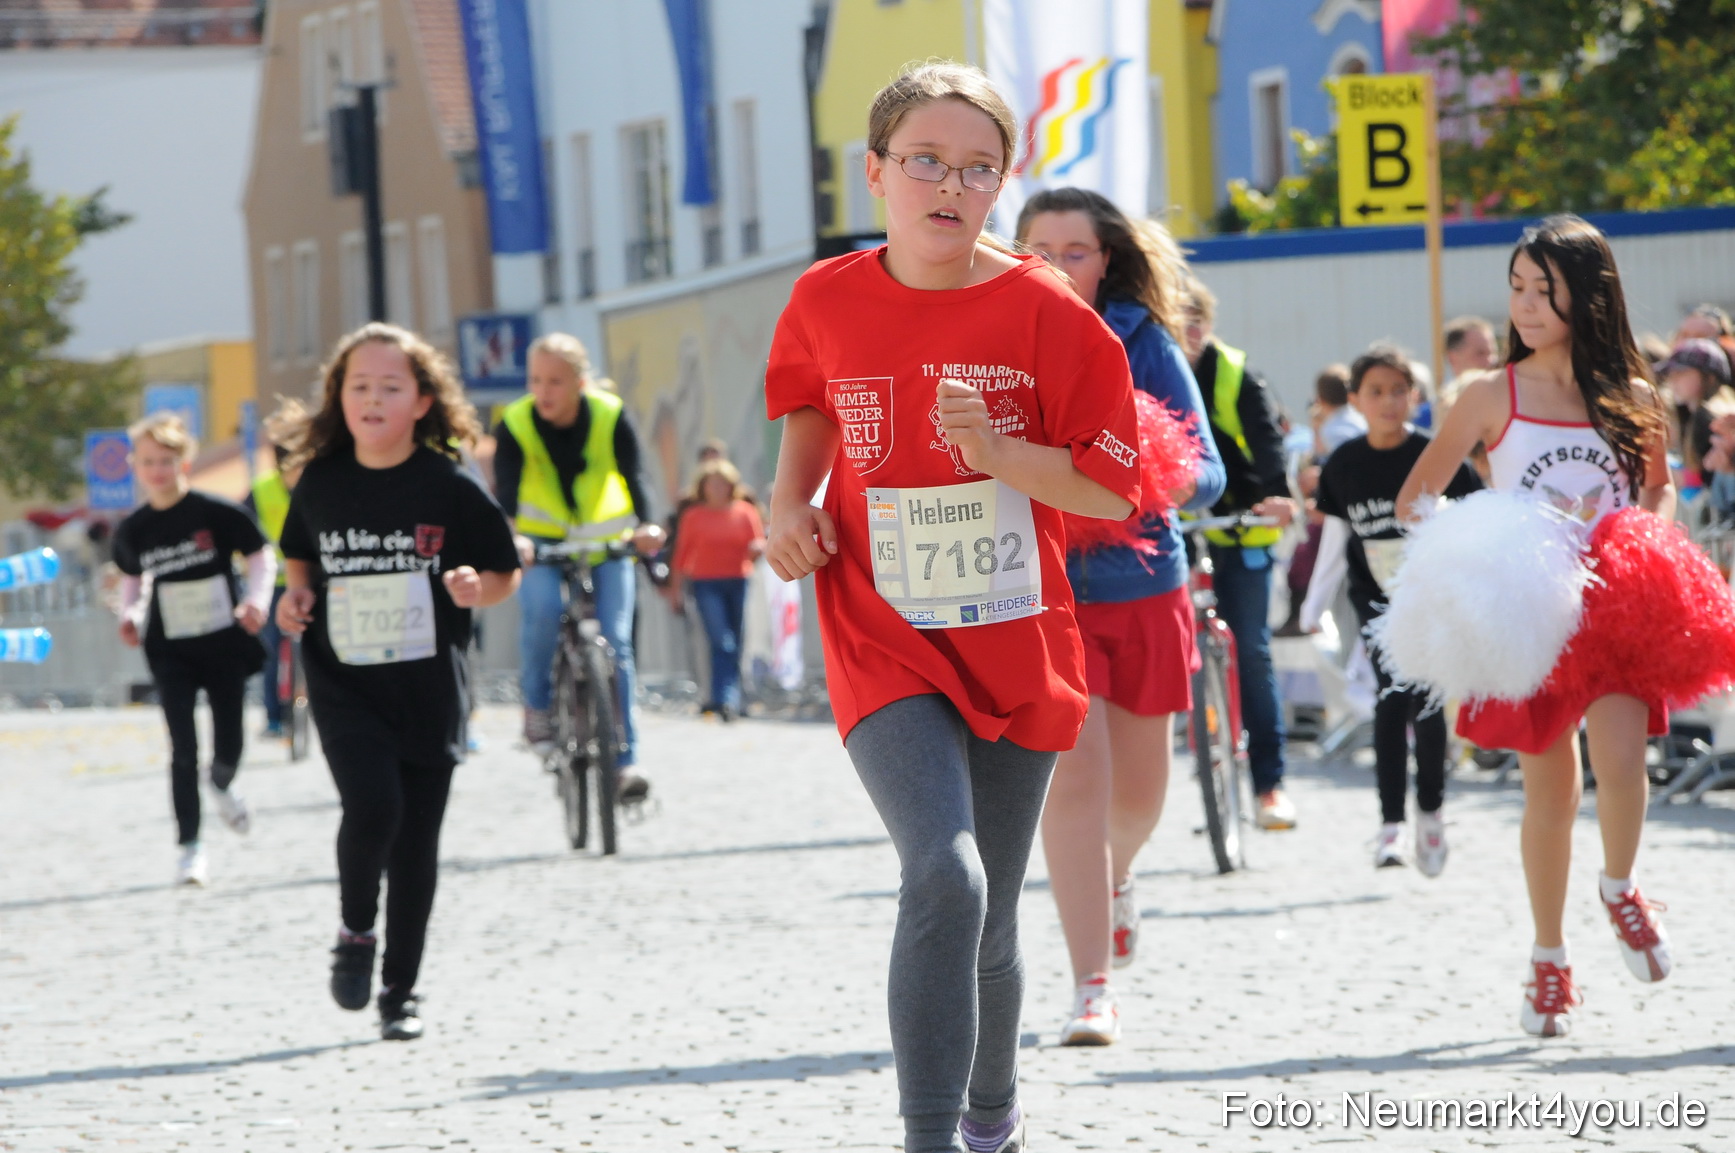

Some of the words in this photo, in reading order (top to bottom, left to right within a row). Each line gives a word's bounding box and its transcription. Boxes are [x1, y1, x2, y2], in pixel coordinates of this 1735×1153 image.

[1350, 82, 1423, 110] Block
[1367, 123, 1411, 189] B
[922, 364, 940, 377] 11.
[851, 382, 868, 391] Jahre
[939, 377, 1020, 392] DTLAUF
[834, 391, 880, 407] IMMER
[843, 422, 881, 444] NEU
[844, 445, 882, 459] MARKT
[1517, 446, 1621, 507] EUTSCHLAND
[908, 498, 983, 525] Helene
[319, 530, 345, 553] Ich
[347, 527, 381, 551] bin
[383, 529, 415, 551] ein
[916, 532, 1025, 580] 7182
[980, 594, 1039, 615] PFLEIDERER
[357, 605, 424, 635] 7022
